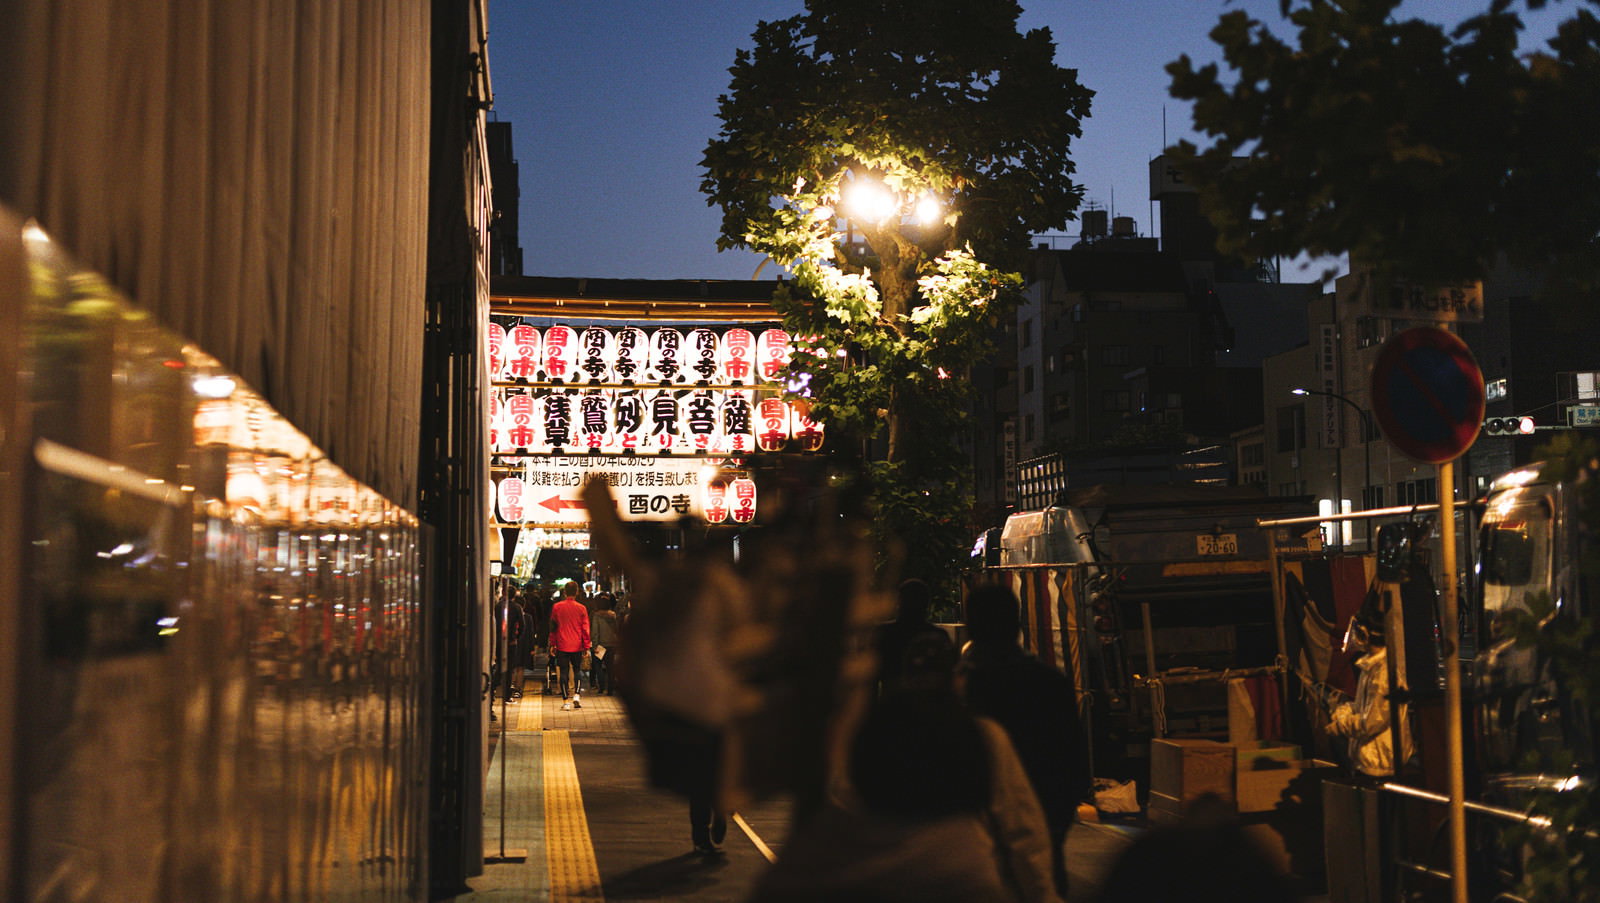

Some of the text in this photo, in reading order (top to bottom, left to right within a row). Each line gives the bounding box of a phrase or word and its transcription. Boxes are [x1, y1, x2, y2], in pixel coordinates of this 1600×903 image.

[510, 326, 537, 377] 酉の市
[544, 326, 568, 377] 酉の市
[724, 330, 750, 379] 酉の市
[508, 395, 535, 447] 酉の市
[760, 399, 787, 450] 酉の市
[502, 480, 524, 520] 酉の市
[628, 494, 691, 514] 酉の寺
[734, 481, 755, 522] 酉の市
